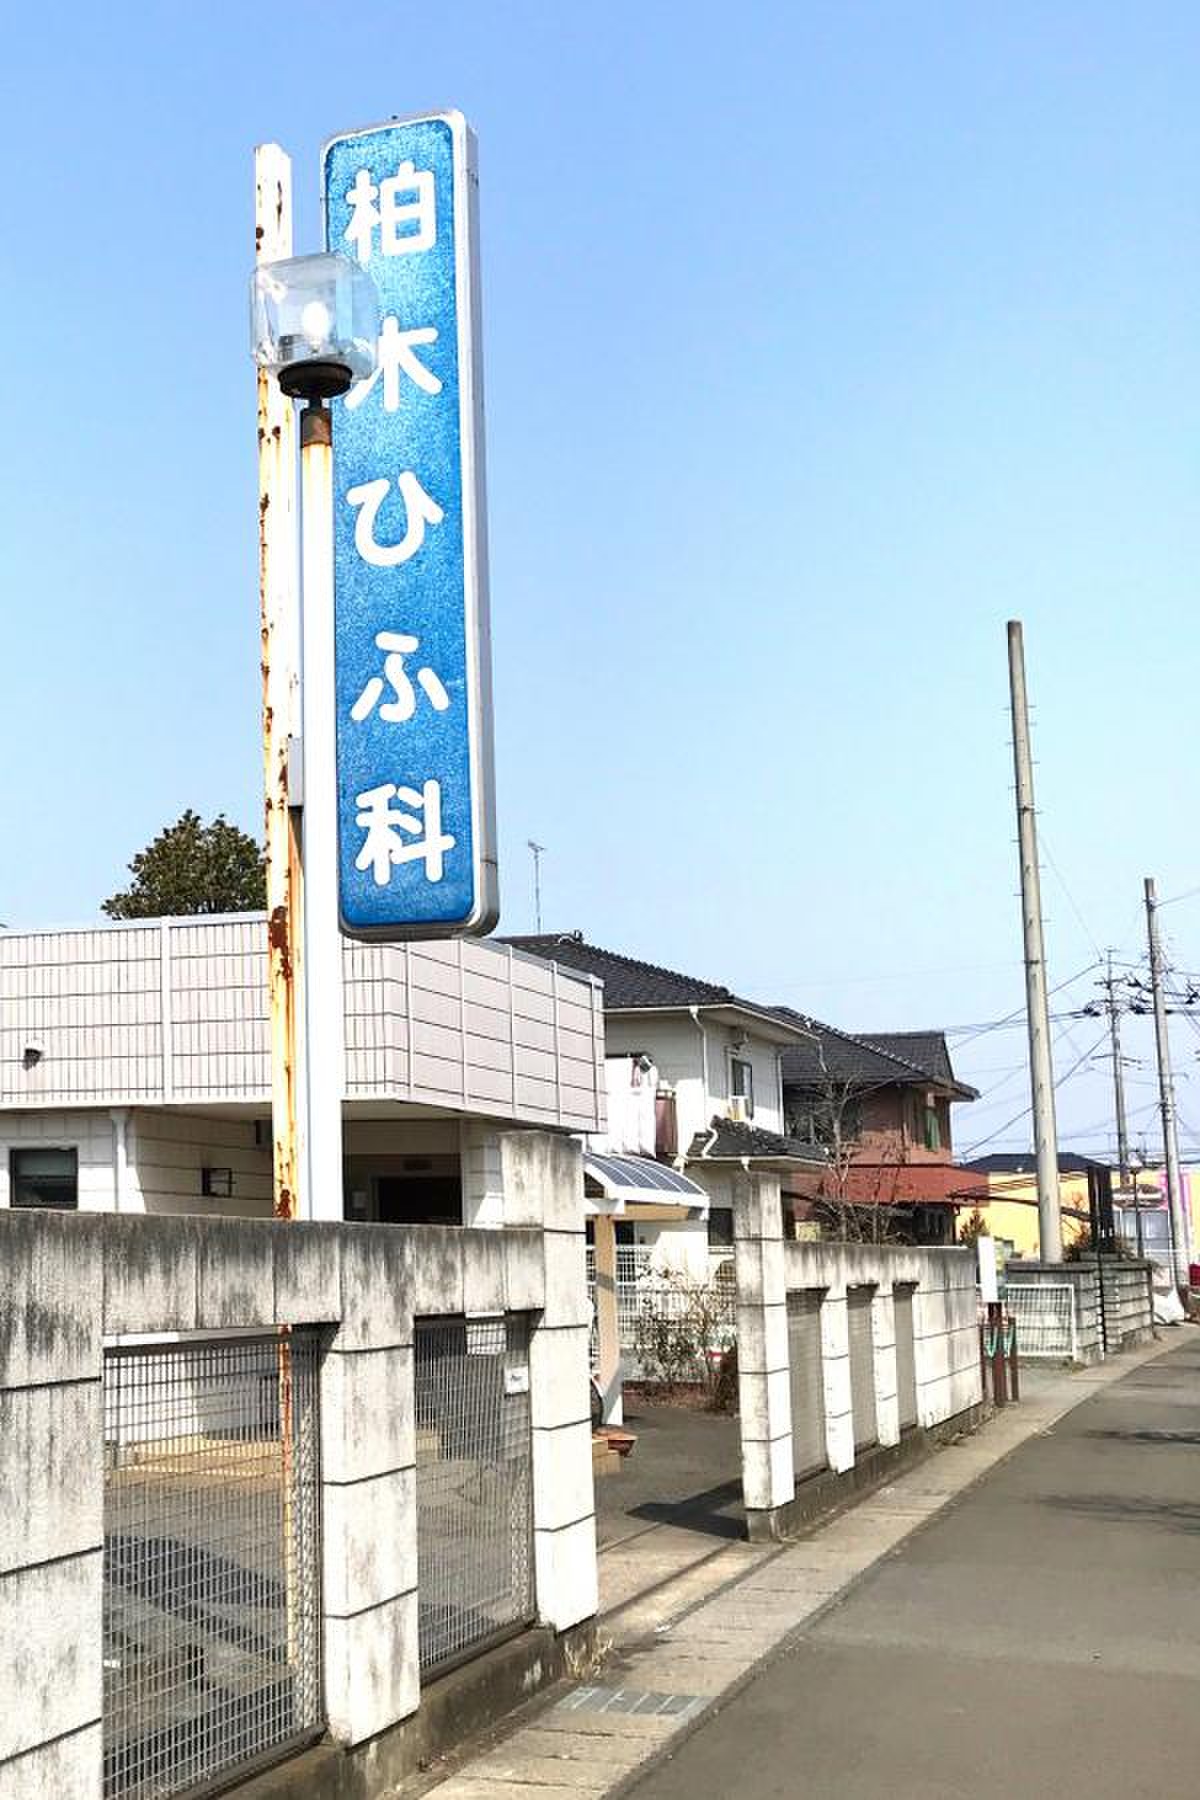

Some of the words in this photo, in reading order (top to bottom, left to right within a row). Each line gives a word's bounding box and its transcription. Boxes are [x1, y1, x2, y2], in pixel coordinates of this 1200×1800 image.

[344, 161, 455, 885] 柏木ひふ科
